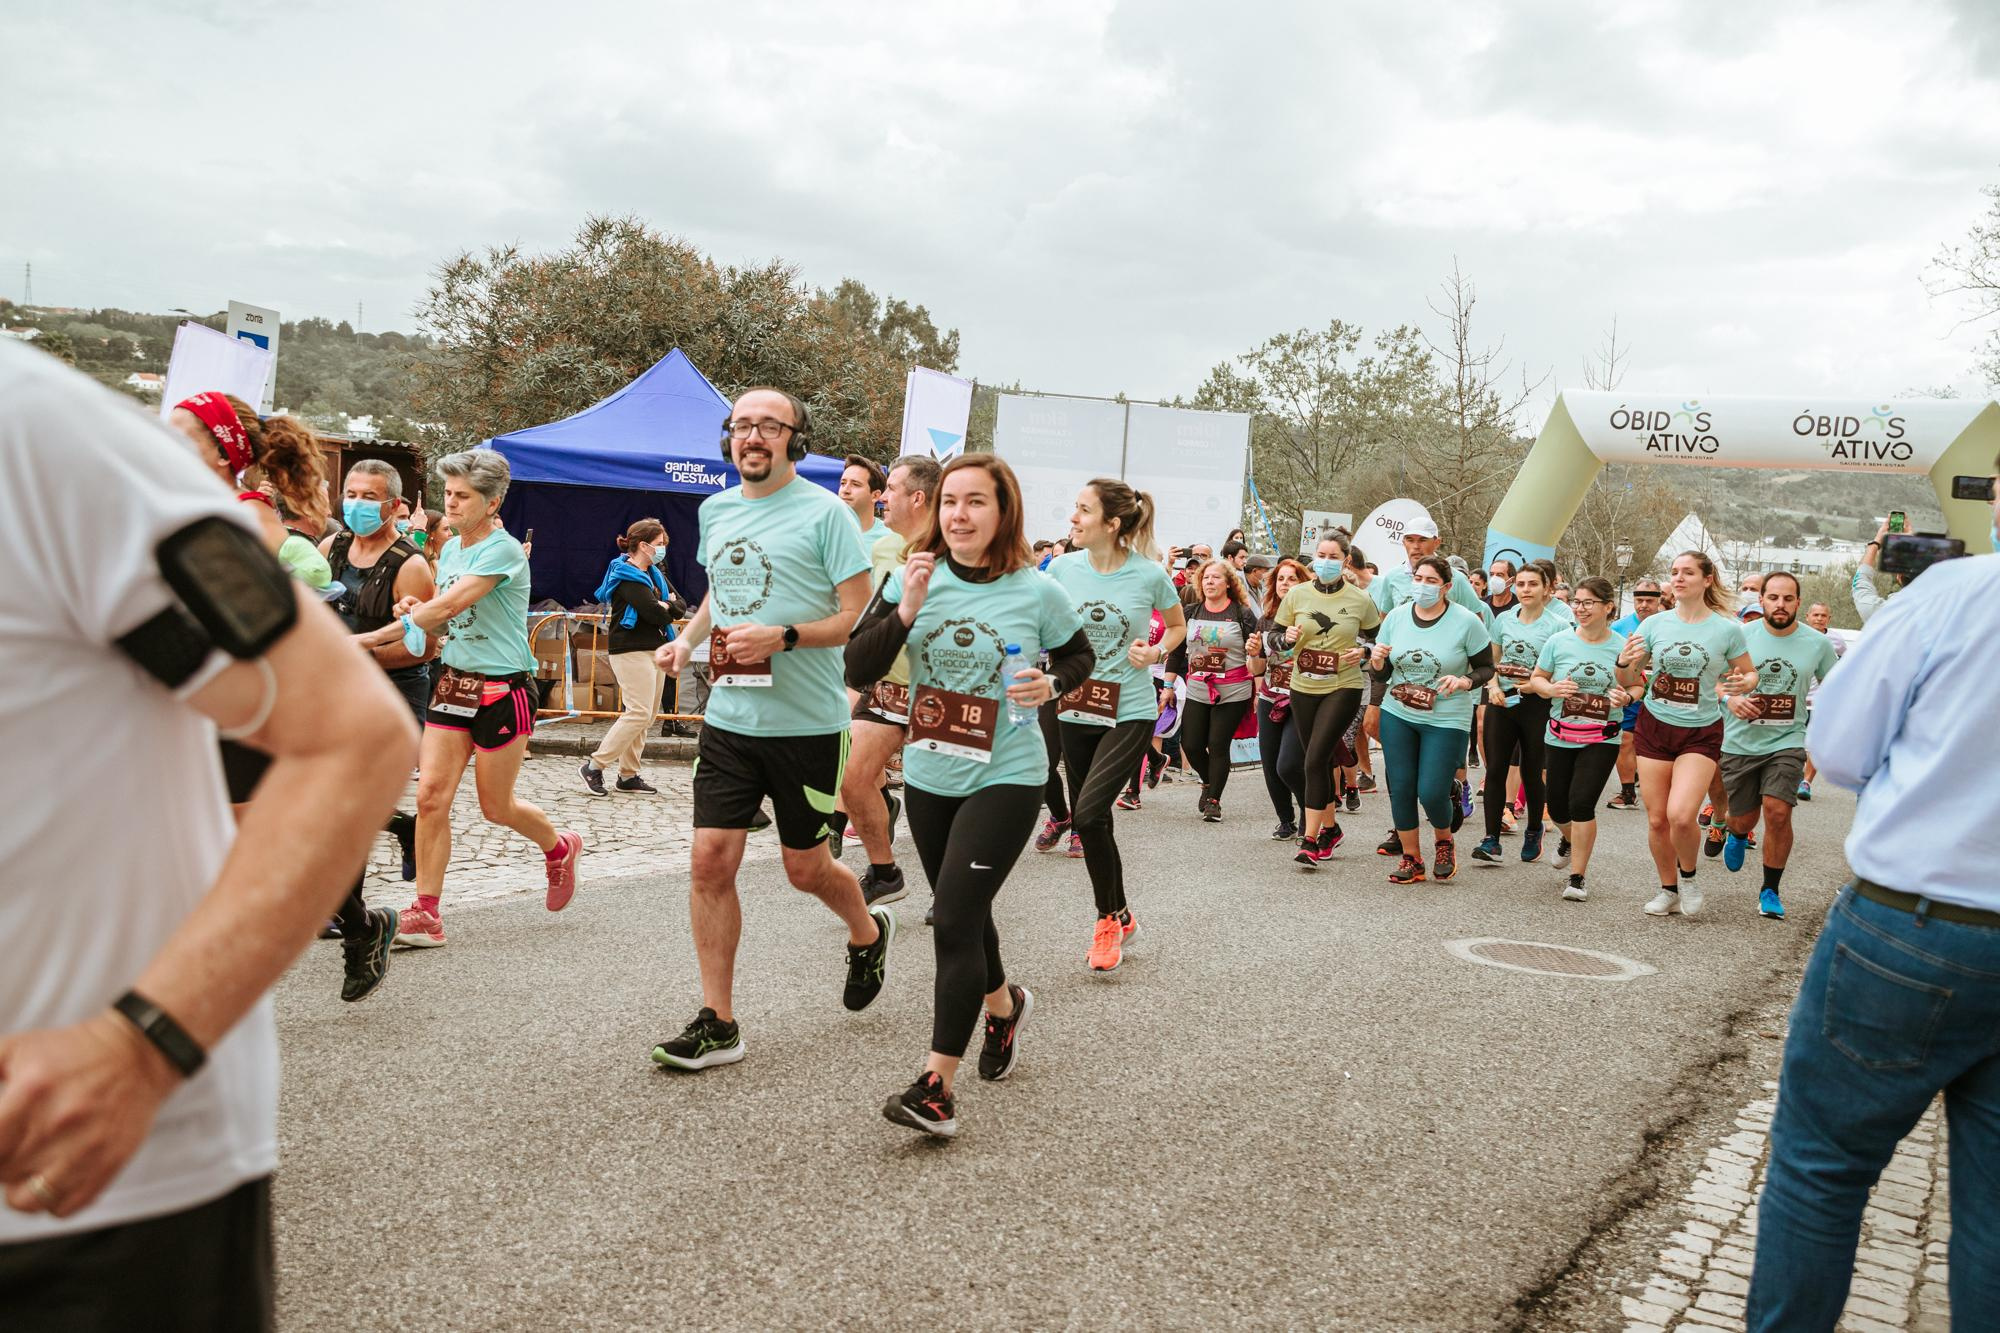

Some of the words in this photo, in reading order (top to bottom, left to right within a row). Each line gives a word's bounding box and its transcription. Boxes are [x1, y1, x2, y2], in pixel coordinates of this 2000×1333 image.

[664, 461, 705, 473] ganhar
[672, 471, 719, 485] DESTAK
[1375, 514, 1405, 531] ÓBID
[716, 568, 747, 577] CORRIDA
[716, 577, 760, 586] CHOCOLATE
[1084, 623, 1107, 631] RRIDA
[1086, 630, 1119, 639] OCOLATE
[932, 648, 975, 659] CORRIDA
[978, 651, 994, 661] DO
[1211, 656, 1220, 665] 16
[1317, 654, 1334, 666] 172
[932, 659, 991, 671] CHOCOLATE
[458, 677, 480, 691] 157
[1674, 681, 1695, 693] 140
[1091, 686, 1110, 700] 52
[1413, 689, 1432, 701] 251
[1591, 698, 1603, 709] 41
[1770, 698, 1792, 709] 225
[961, 704, 982, 725] 18
